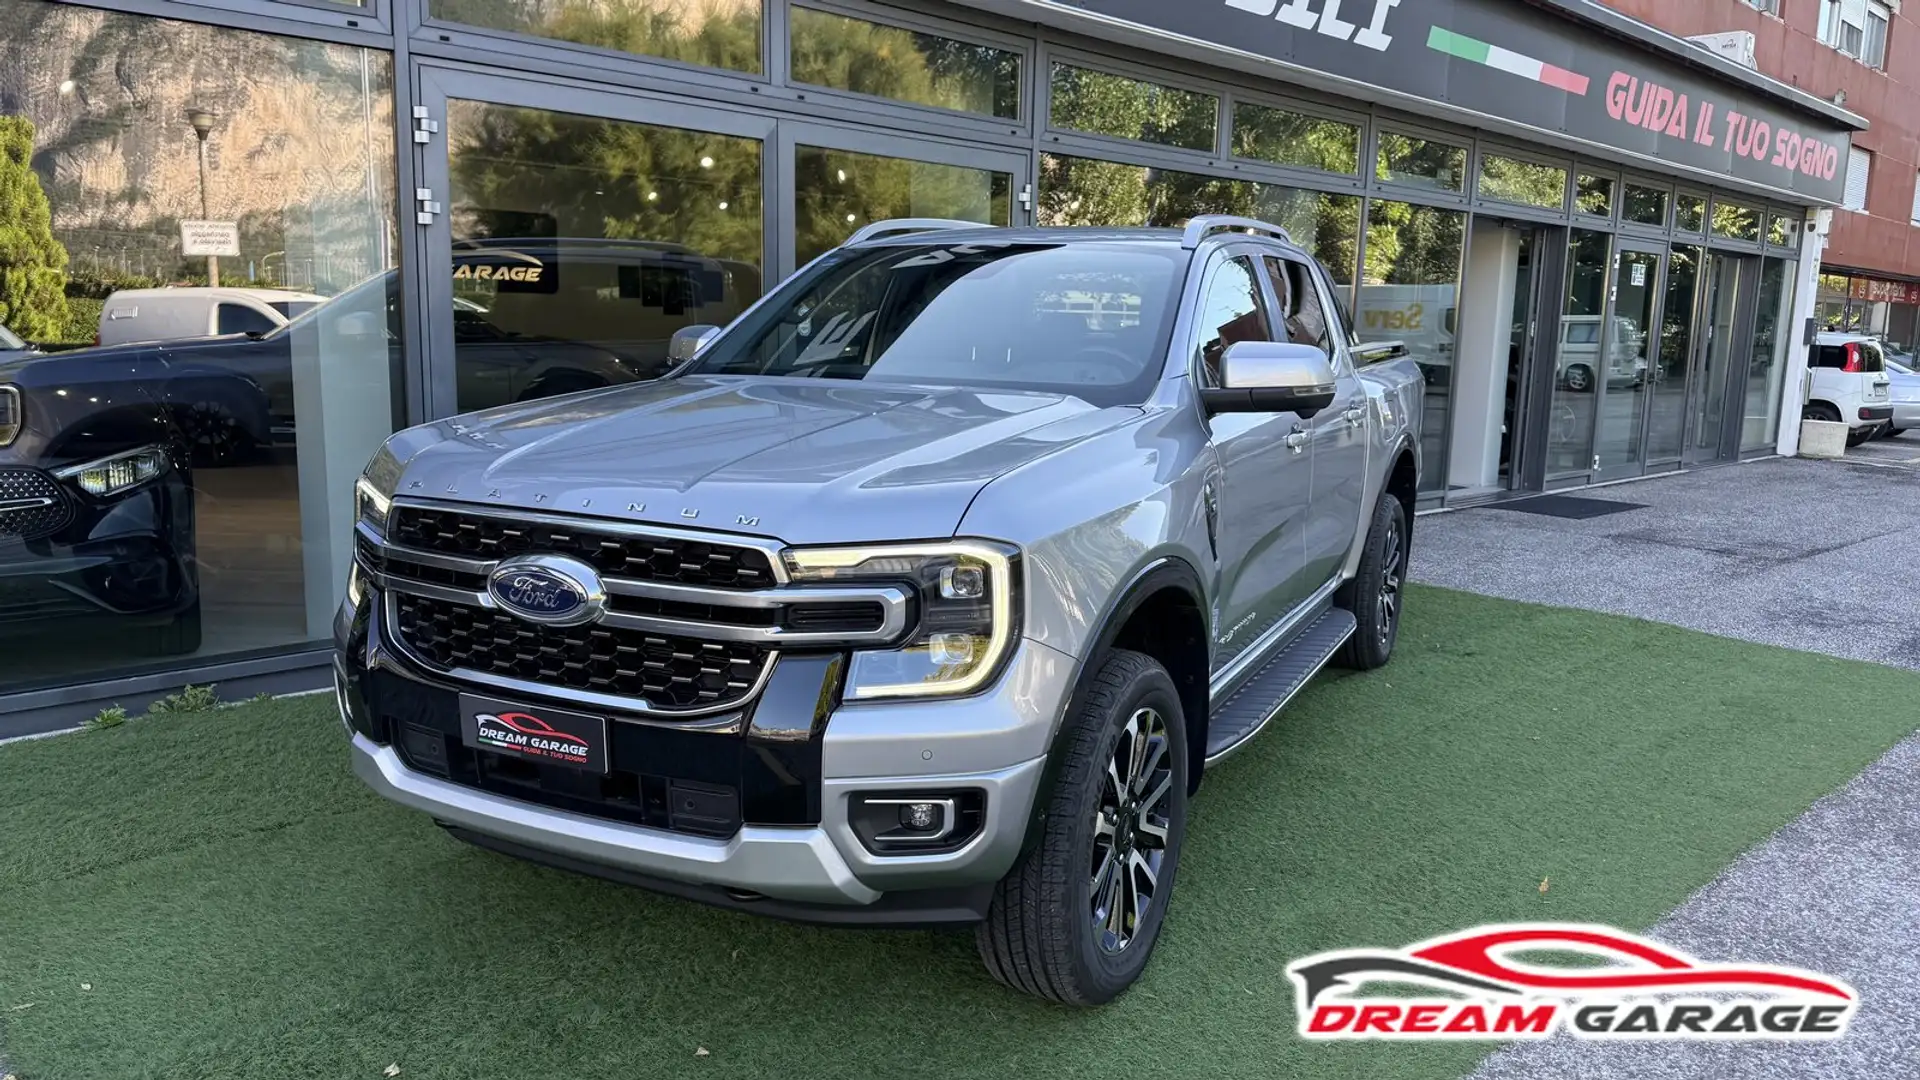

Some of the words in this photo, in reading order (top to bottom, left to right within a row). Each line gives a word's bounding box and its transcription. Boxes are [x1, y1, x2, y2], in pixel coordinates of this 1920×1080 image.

[1605, 70, 1688, 140] GUIDA
[1693, 101, 1715, 147] IL
[1724, 110, 1771, 161] TUO
[1771, 128, 1838, 181] SOGNO
[452, 264, 543, 282] ARAGE
[409, 481, 760, 526] PLATINUM
[509, 576, 561, 608] Ford
[479, 727, 528, 745] DREAM
[530, 738, 588, 756] GARAGE
